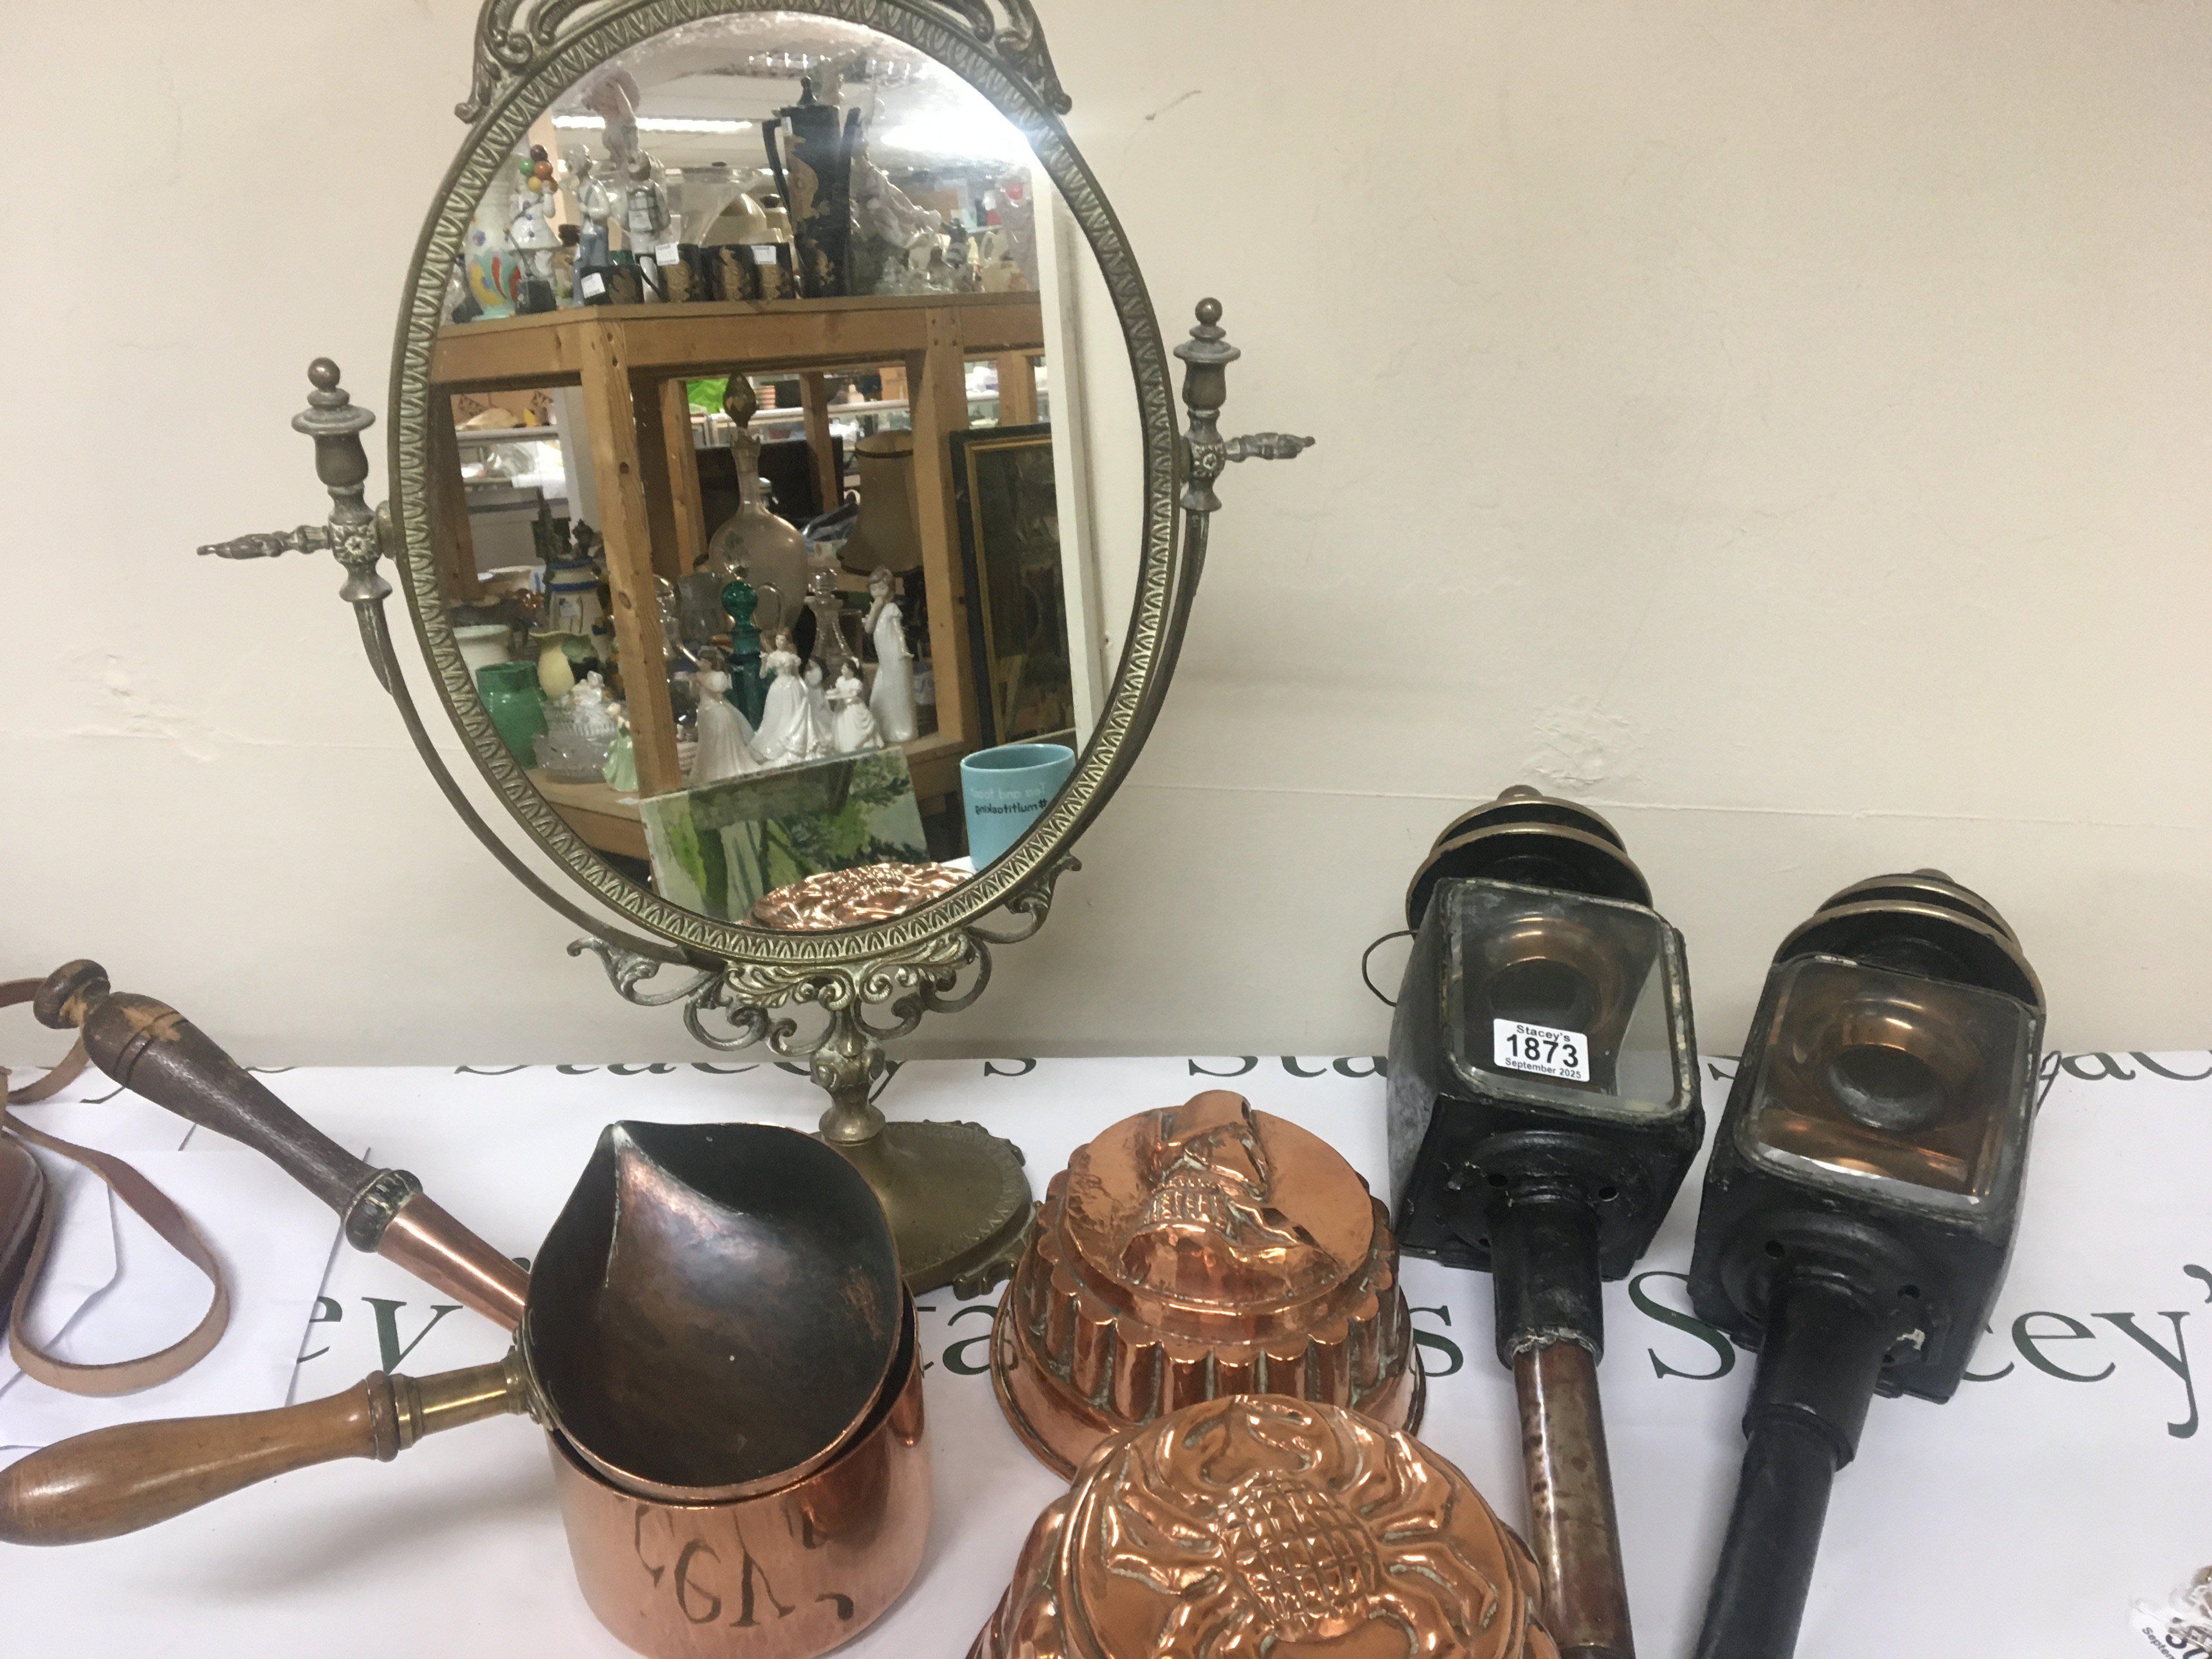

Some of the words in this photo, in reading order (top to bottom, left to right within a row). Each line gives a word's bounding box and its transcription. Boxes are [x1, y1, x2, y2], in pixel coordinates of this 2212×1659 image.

[1516, 1024, 1571, 1042] Stacey's
[1506, 1034, 1579, 1068] 1873
[1505, 1057, 1556, 1075] September
[1559, 1068, 1582, 1079] 2025
